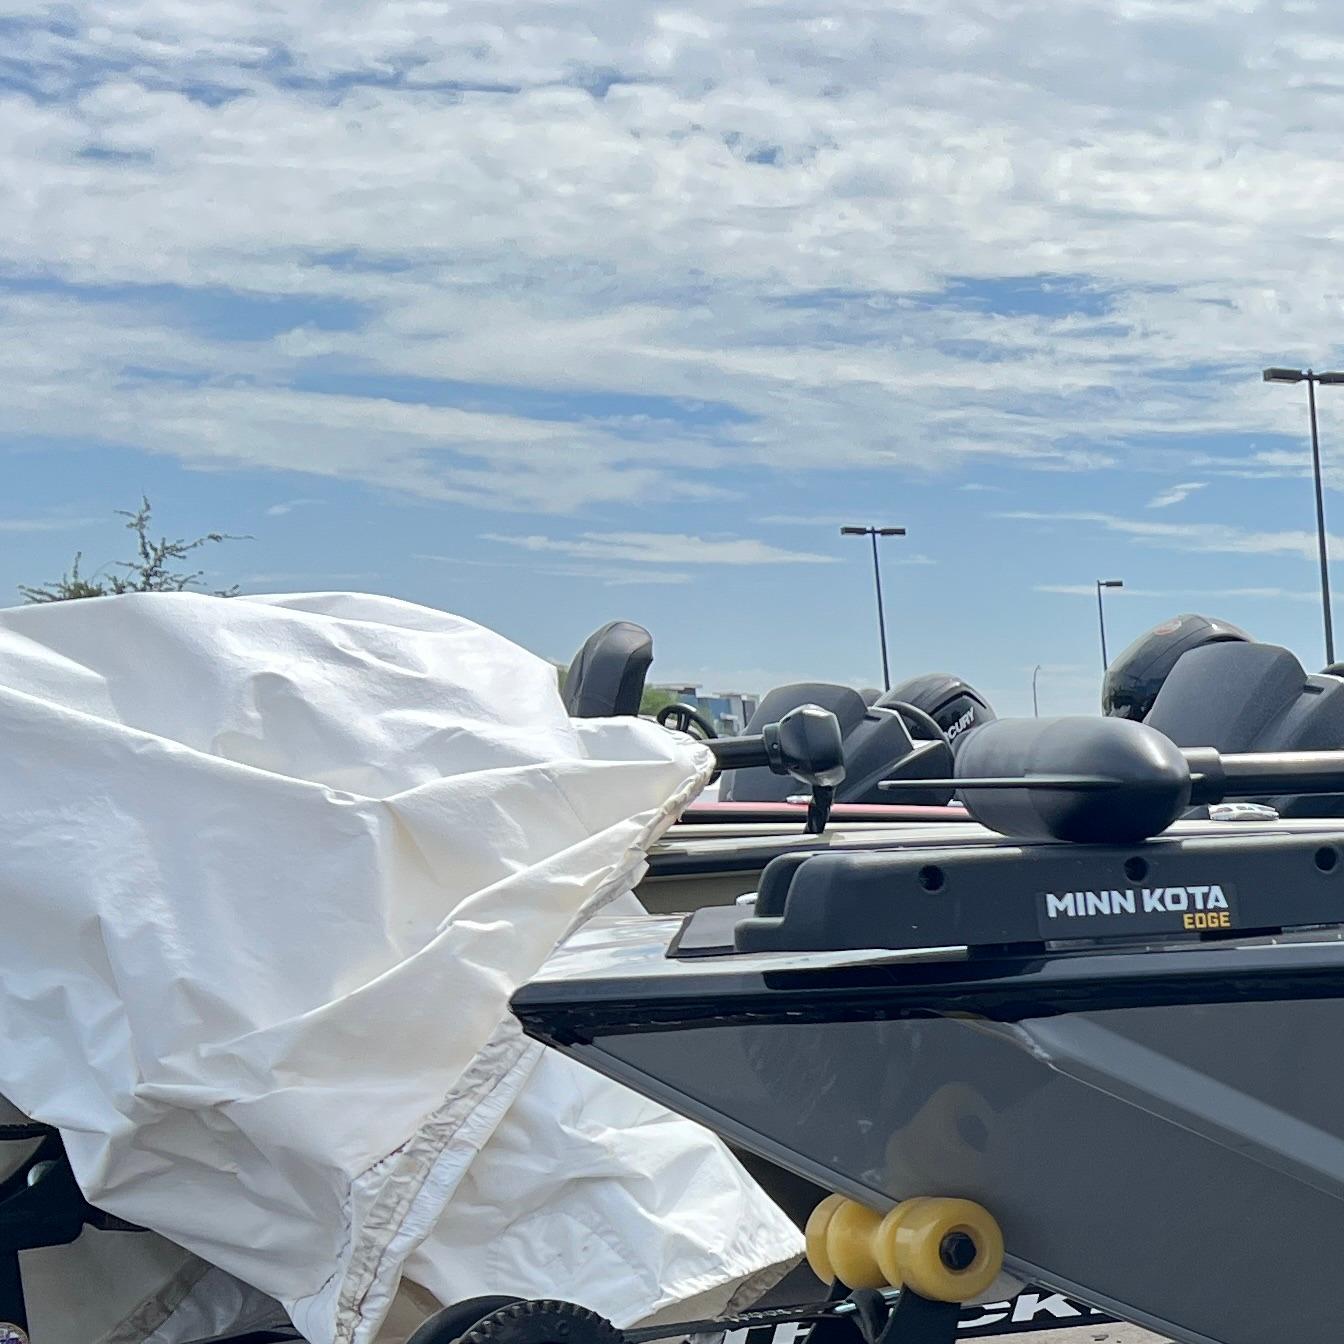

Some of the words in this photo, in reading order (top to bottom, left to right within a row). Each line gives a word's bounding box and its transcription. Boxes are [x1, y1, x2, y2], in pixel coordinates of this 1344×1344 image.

[944, 706, 974, 739] CURY
[1046, 889, 1136, 918] MINN
[1141, 885, 1229, 913] KOTA
[1183, 911, 1231, 929] EDGE
